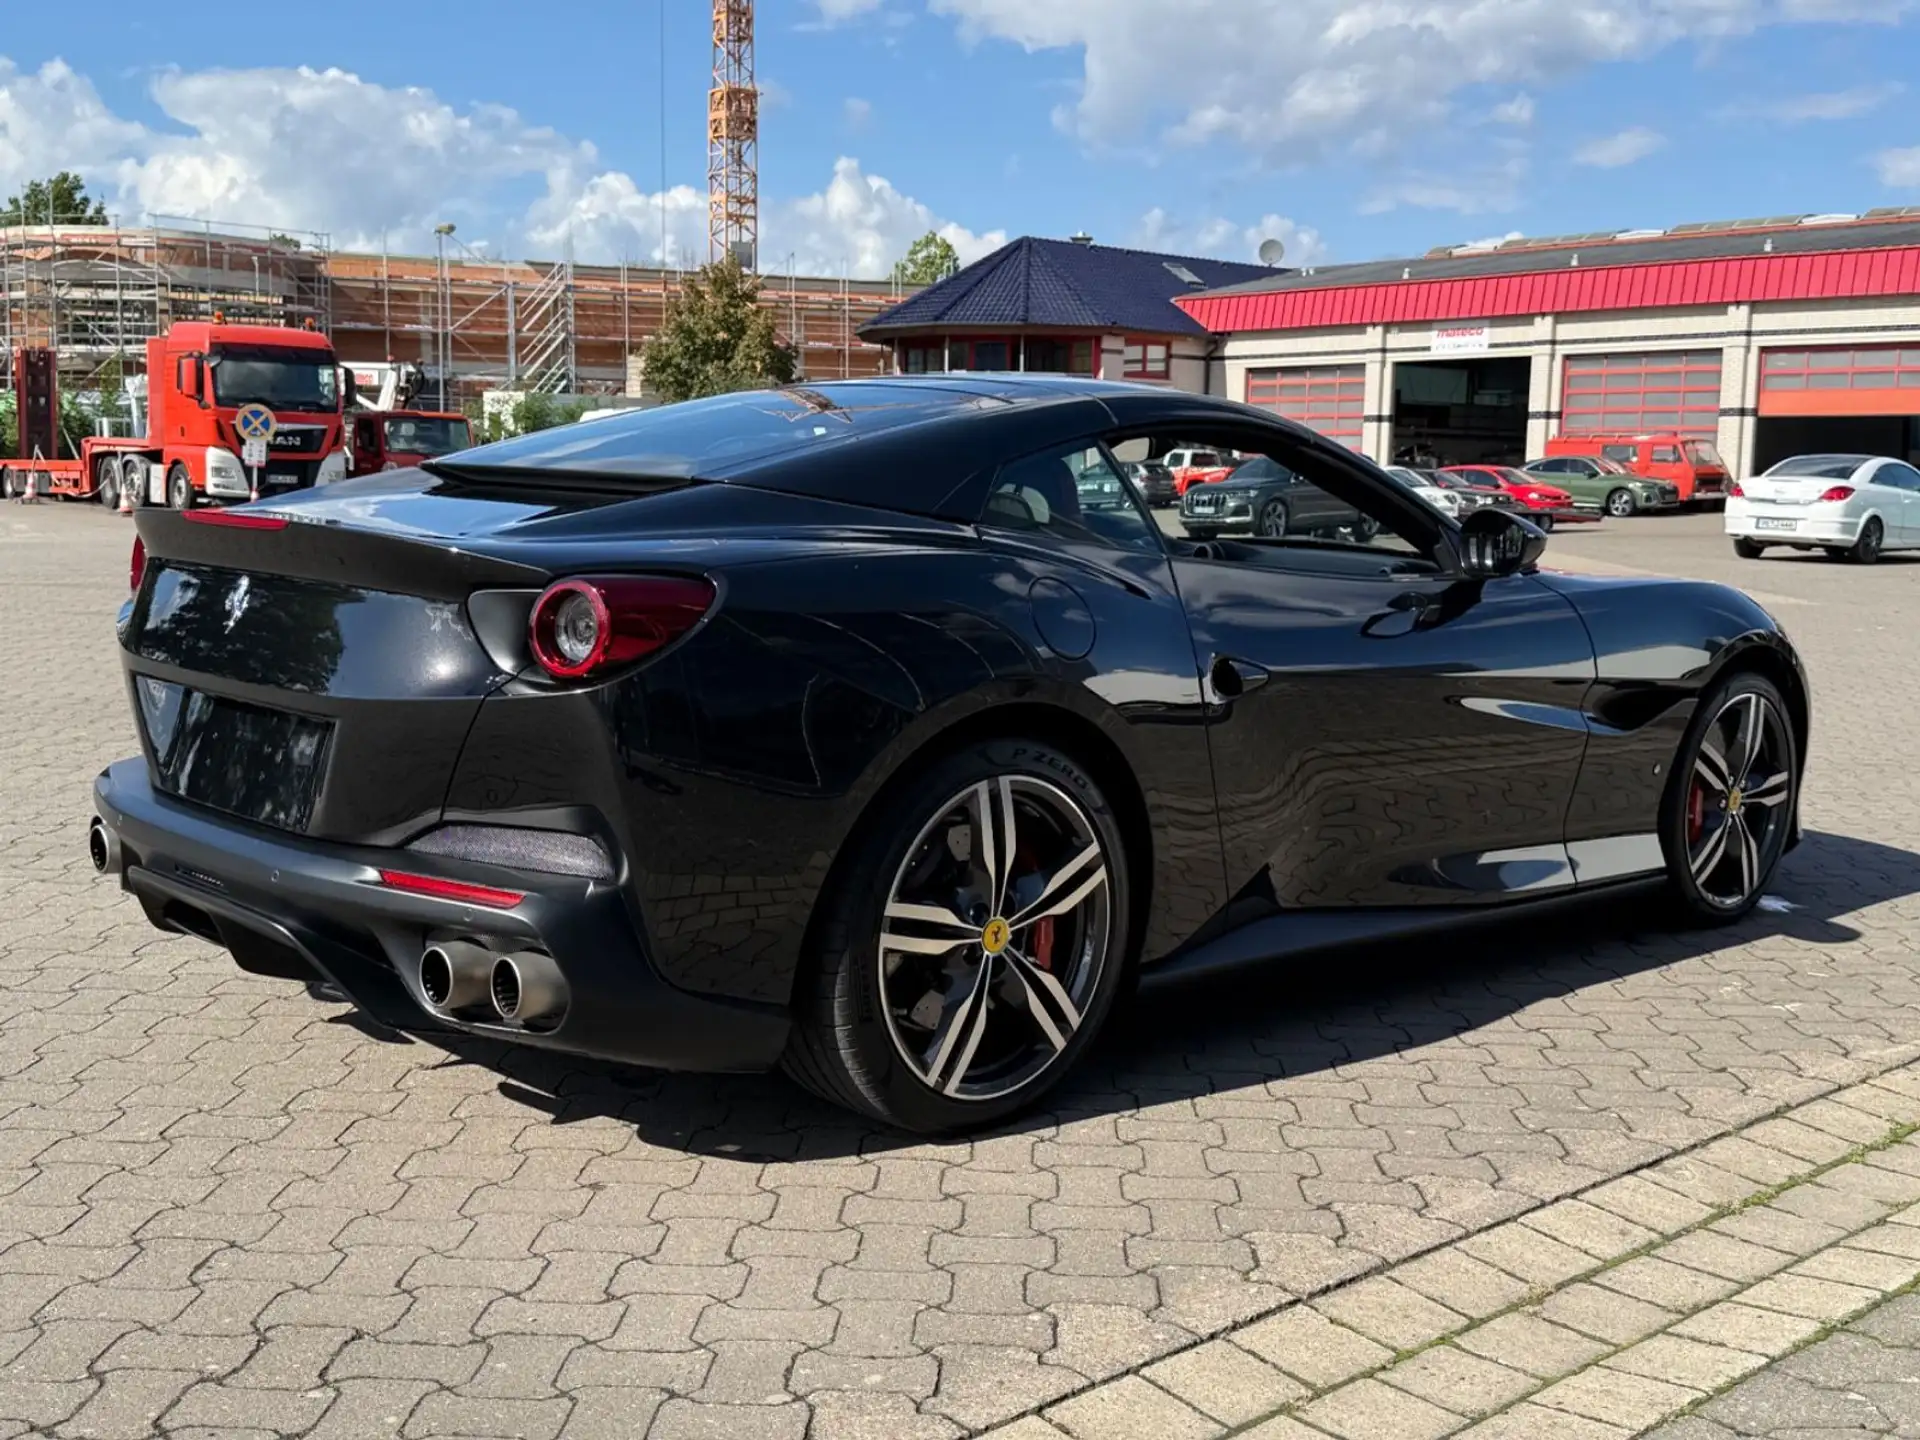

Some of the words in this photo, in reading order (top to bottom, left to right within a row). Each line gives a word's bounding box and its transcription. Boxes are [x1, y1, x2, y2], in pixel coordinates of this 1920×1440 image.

[1436, 327, 1485, 339] mateco
[1011, 747, 1028, 760] P
[1032, 750, 1089, 790] ZERO
